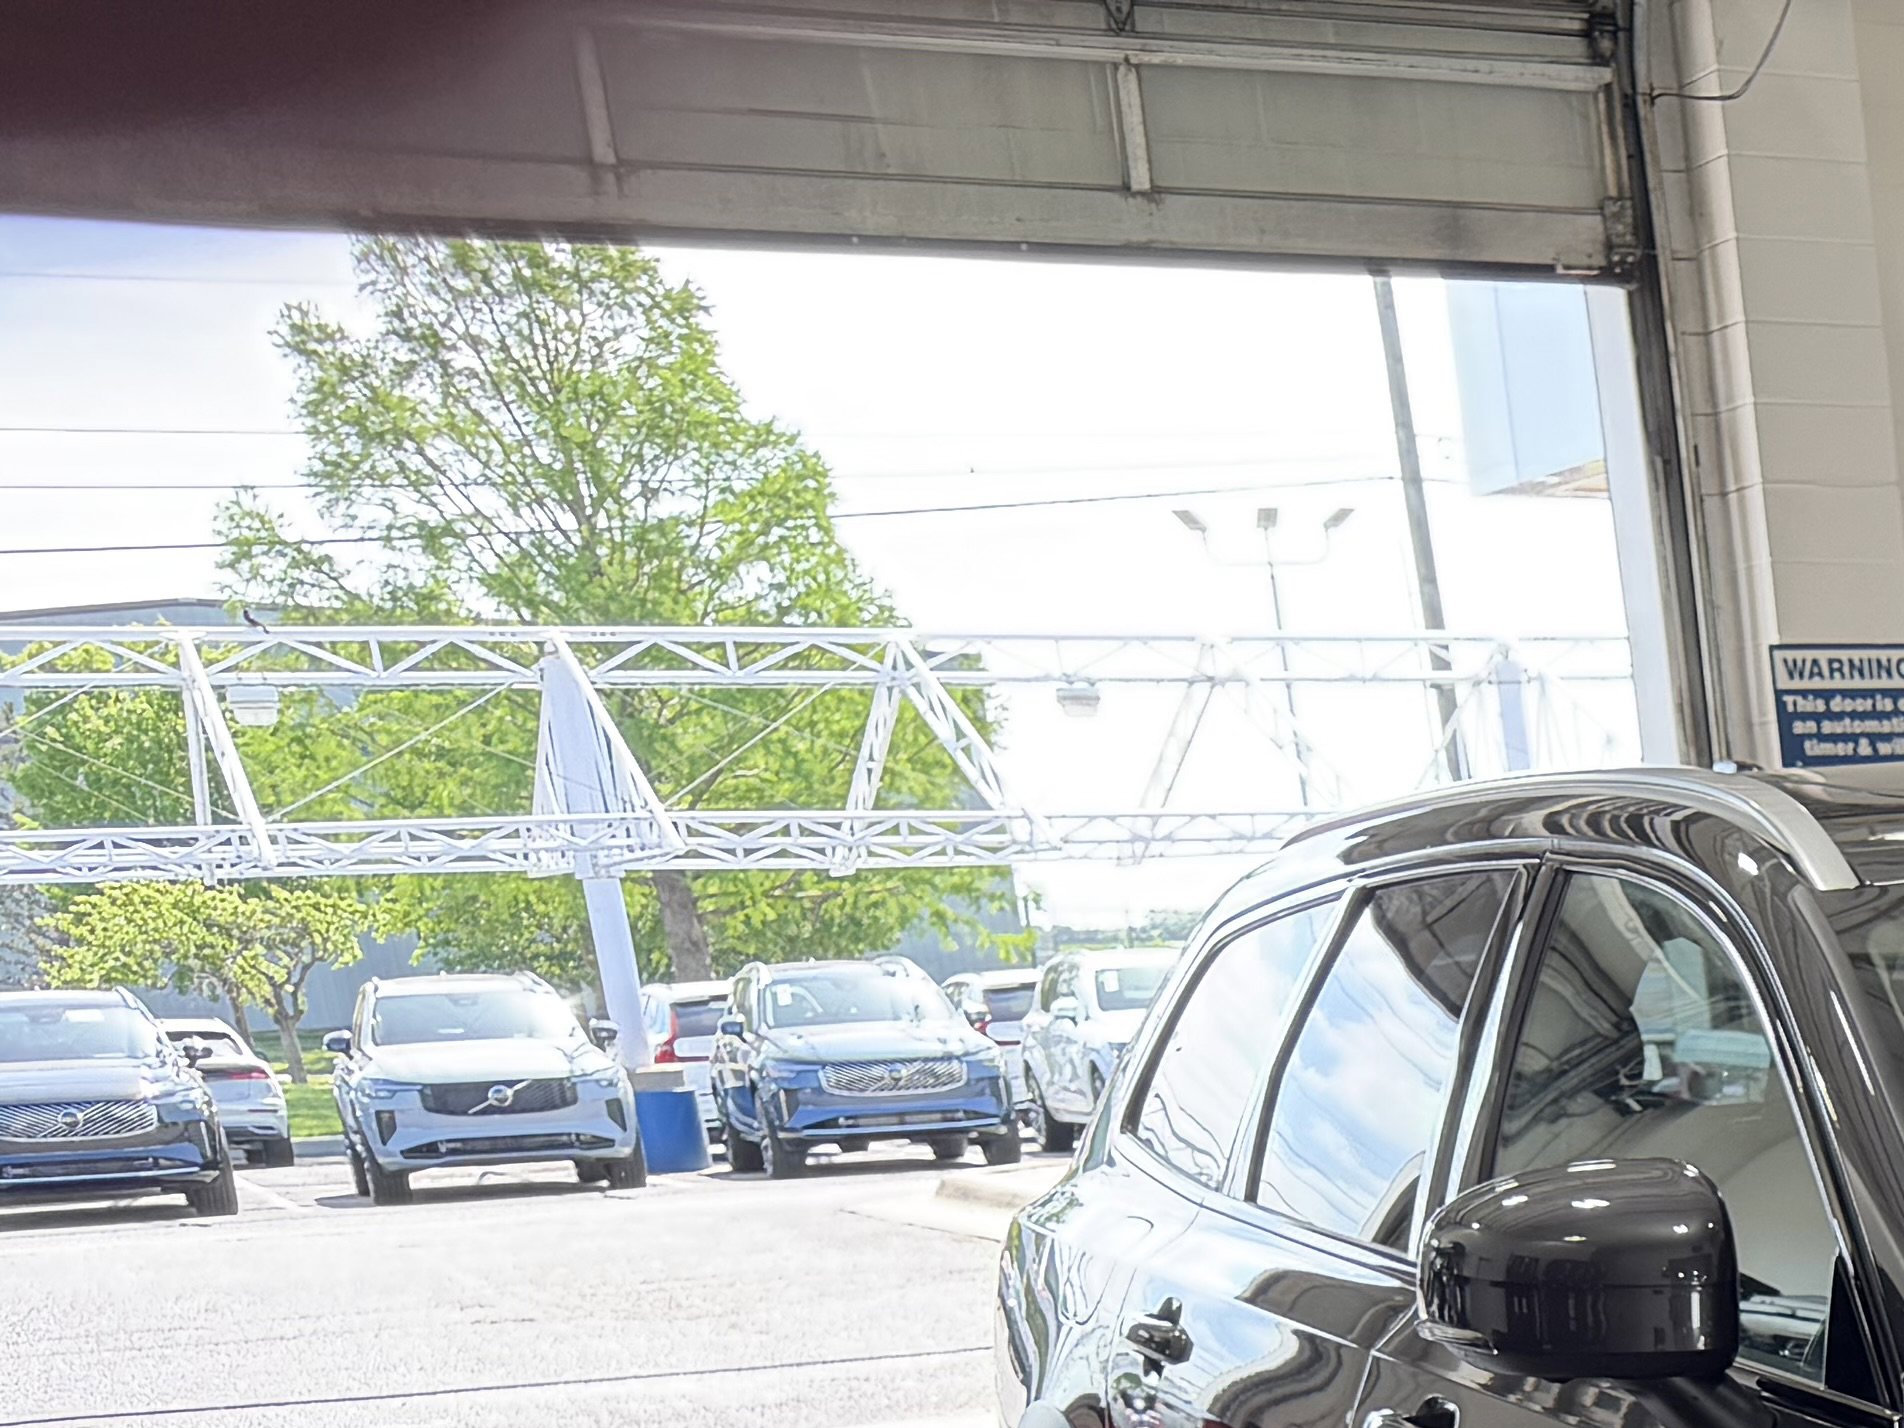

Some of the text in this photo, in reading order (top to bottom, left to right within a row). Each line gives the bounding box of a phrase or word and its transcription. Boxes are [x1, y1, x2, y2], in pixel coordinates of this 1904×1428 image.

[1783, 695, 1826, 713] This
[1830, 694, 1873, 713] door
[1876, 694, 1895, 712] is
[1792, 720, 1818, 735] an
[1803, 739, 1855, 756] timer
[1857, 737, 1873, 756] &
